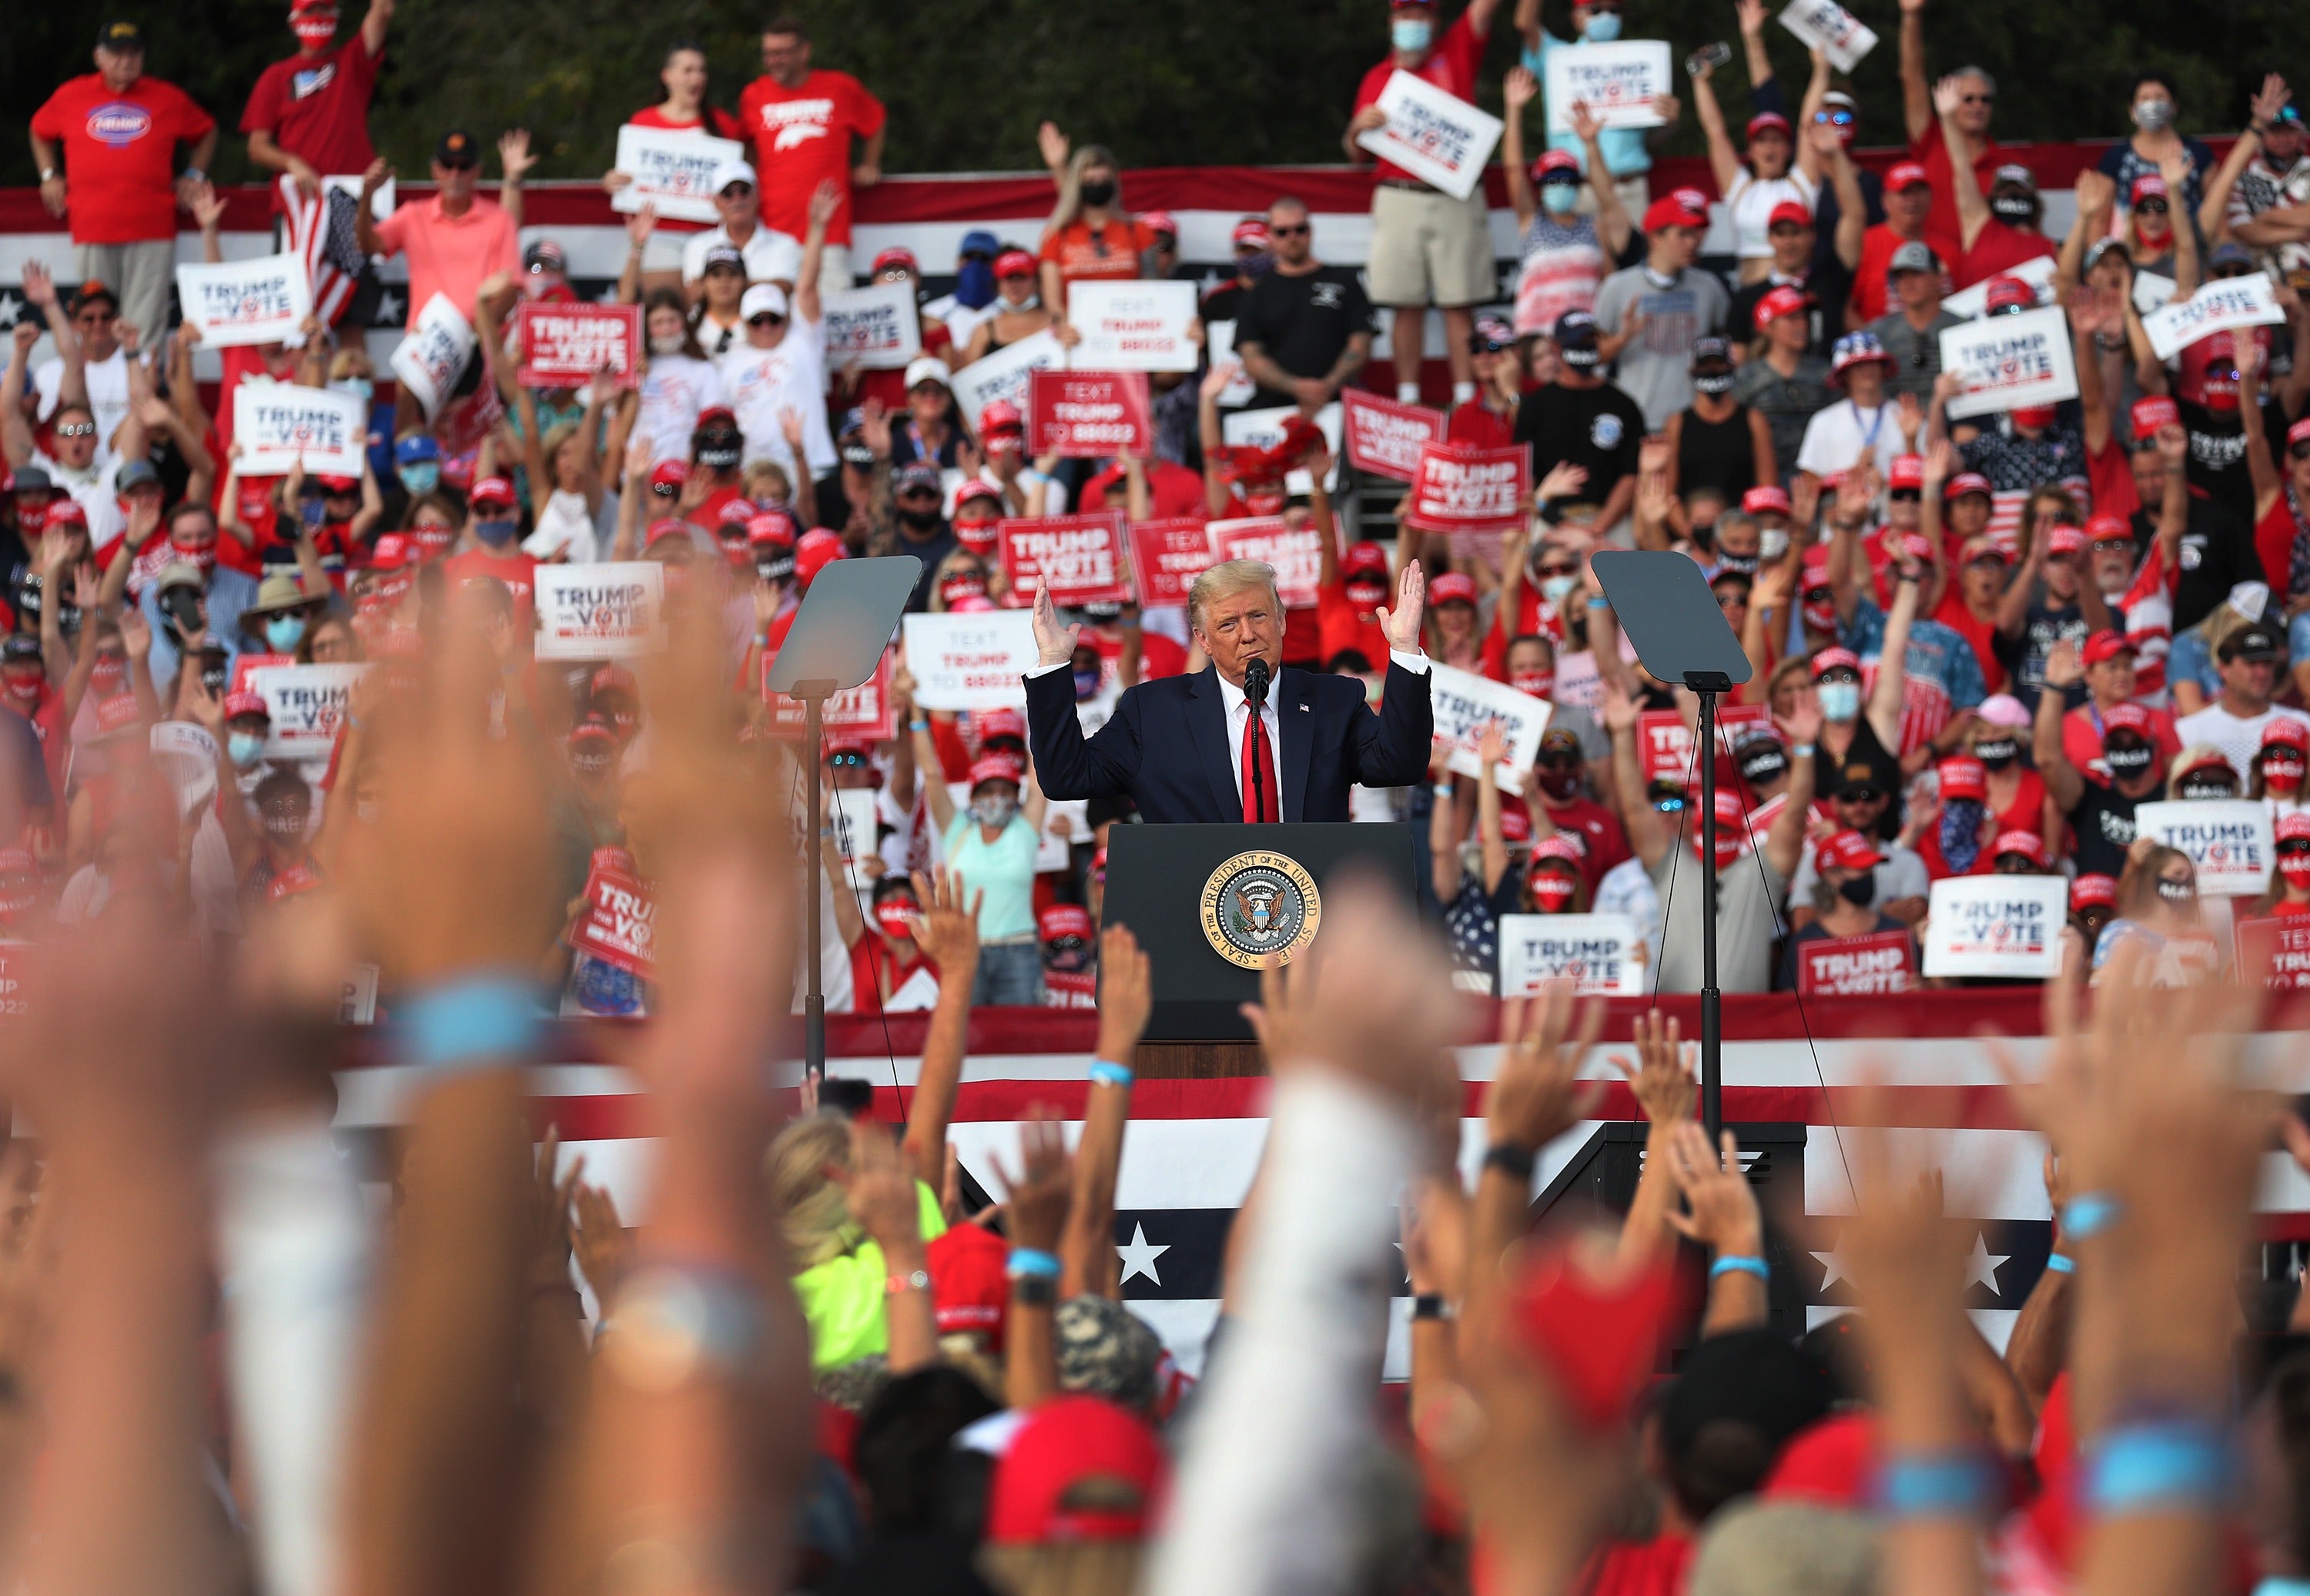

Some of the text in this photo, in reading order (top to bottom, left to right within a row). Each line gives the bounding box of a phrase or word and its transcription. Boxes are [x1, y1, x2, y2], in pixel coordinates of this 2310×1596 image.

[1568, 63, 1649, 82] TRUMP
[1398, 95, 1475, 142] TRUMP
[639, 149, 719, 170] TRUMP
[201, 276, 286, 299] TRUMP
[228, 294, 292, 317] VOTE
[530, 316, 627, 340] TRUMP
[1100, 318, 1164, 333] TRUMP
[555, 340, 627, 363] VOTE
[1960, 334, 2047, 365] TRUMP
[1984, 352, 2051, 380] VOTE
[1064, 381, 1110, 400] TEXT
[255, 405, 342, 426] TRUMP
[1054, 402, 1124, 421] TRUMP
[1072, 422, 1136, 442] 88022
[1352, 405, 1431, 441] TRUMP
[280, 425, 343, 446] VOTE
[1419, 458, 1518, 482] TRUMP
[1445, 482, 1517, 506] VOTE
[1009, 528, 1110, 556] TRUMP
[1164, 531, 1200, 550] TEX
[1226, 529, 1321, 560] TRUMP
[1036, 548, 1113, 583] VOTE
[1157, 552, 1212, 571] TRUM
[553, 586, 645, 605] TRUMP
[951, 631, 997, 647] TEXT
[942, 651, 1010, 669] TRUMP
[277, 688, 349, 707] TRUM
[1438, 691, 1522, 729] TRUMP
[2161, 824, 2255, 845] TRUMP
[1259, 855, 1272, 864] OF
[1274, 857, 1289, 869] THE
[2191, 844, 2259, 863] VOTE
[1204, 855, 1257, 908] PRESIDENT
[599, 880, 653, 922] TRU
[1291, 868, 1317, 917] UNITED
[1206, 912, 1215, 929] THE
[1950, 901, 2044, 922] TRUMP
[614, 912, 653, 945] VO
[1210, 930, 1221, 942] OF
[1970, 922, 2045, 942] VOTE
[2279, 928, 2310, 950] TEX
[1220, 941, 1251, 965] SEAL
[1524, 939, 1620, 959] TRUMP
[1548, 959, 1621, 982] VOTE
[1810, 947, 1903, 980] TRUMP
[2272, 952, 2310, 972] TRU
[1835, 971, 1907, 995] VOTE
